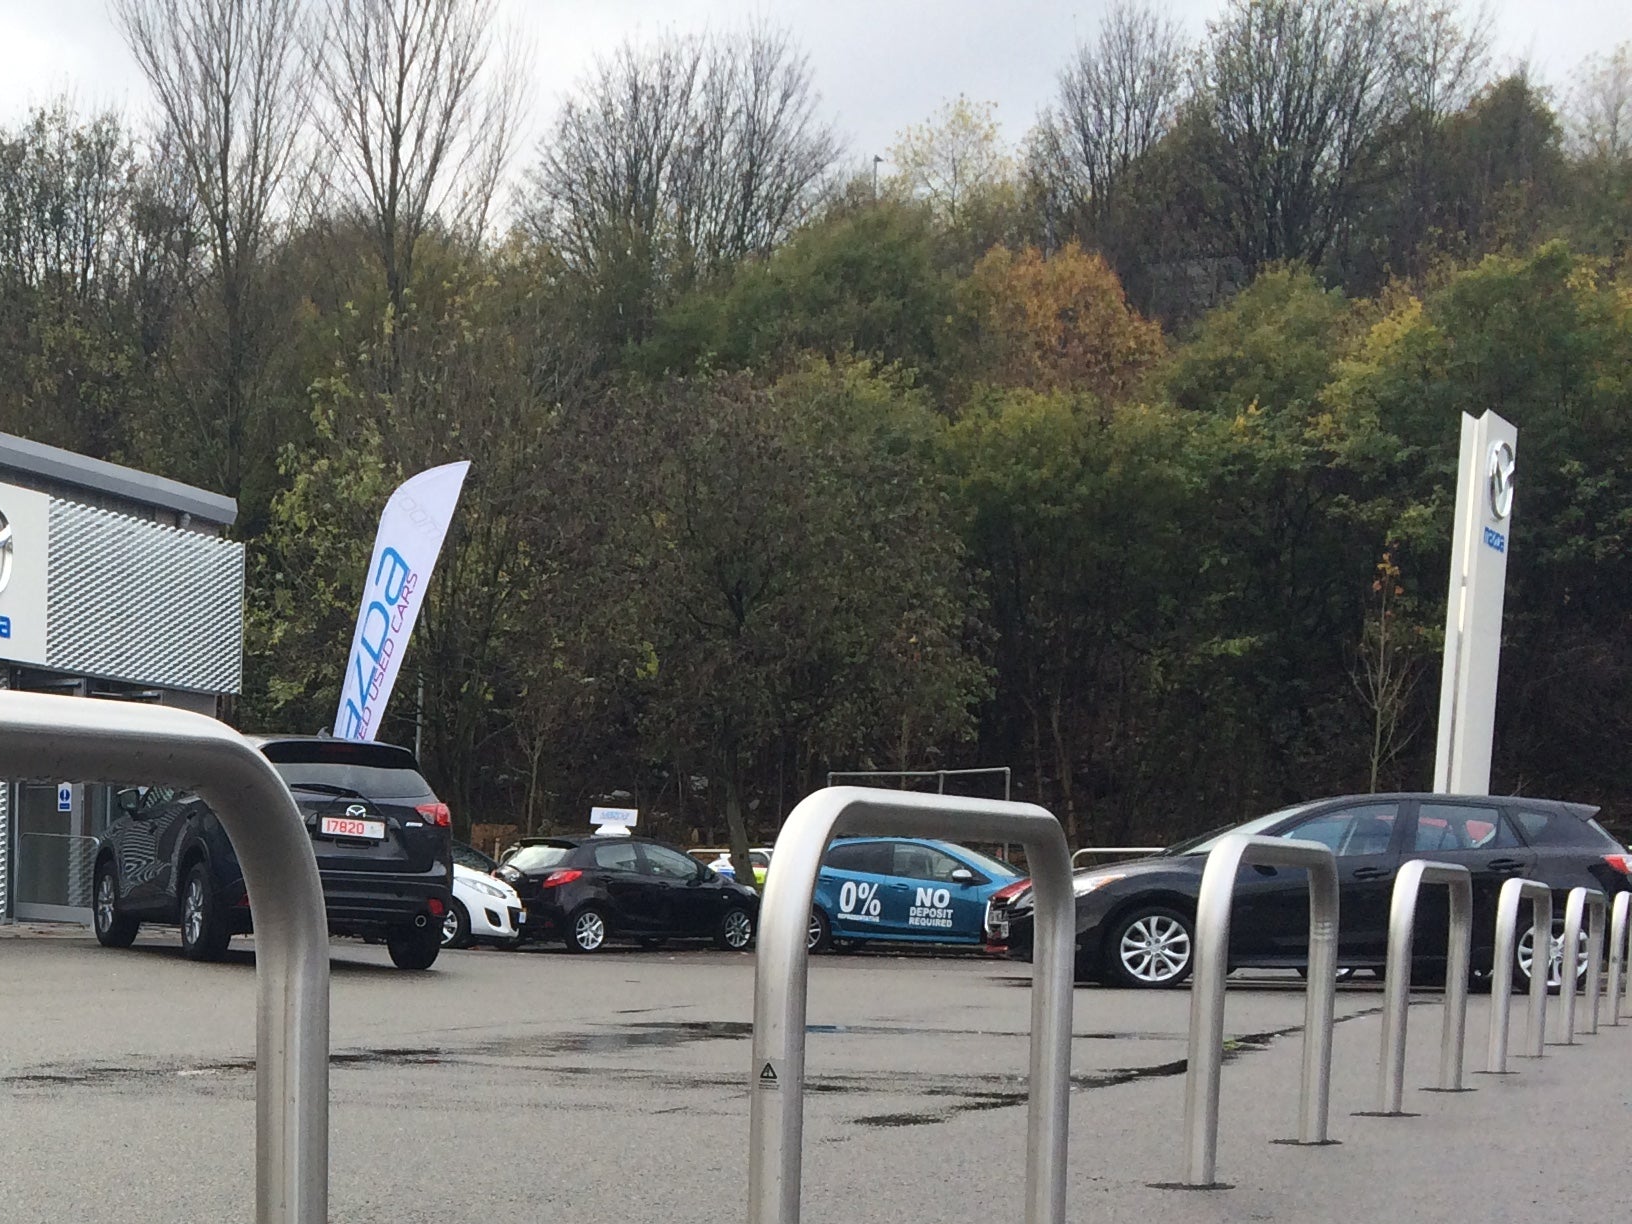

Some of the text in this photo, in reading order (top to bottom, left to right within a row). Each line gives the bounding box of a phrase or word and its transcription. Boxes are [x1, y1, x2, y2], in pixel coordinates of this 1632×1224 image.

[369, 638, 395, 701] USED
[391, 569, 418, 634] CARS
[326, 820, 365, 835] 17820
[839, 881, 881, 916] 0%
[915, 887, 951, 908] NO
[909, 906, 953, 919] DEPOSIT
[909, 916, 953, 928] REQUIRED
